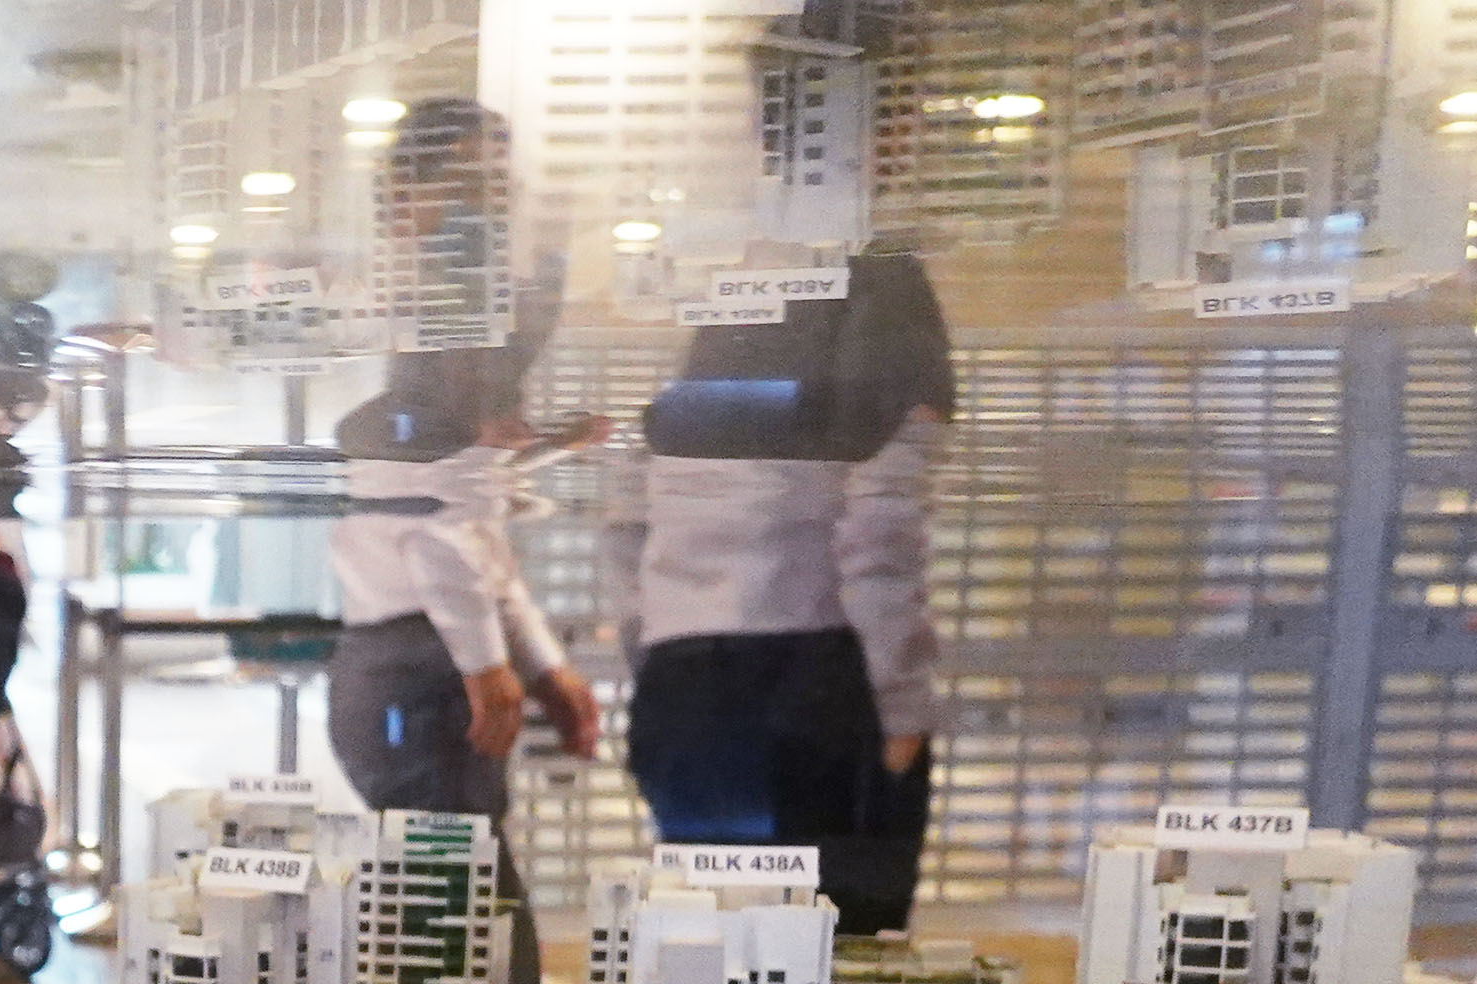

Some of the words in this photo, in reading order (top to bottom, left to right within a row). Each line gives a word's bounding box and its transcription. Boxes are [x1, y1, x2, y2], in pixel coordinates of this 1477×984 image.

[1165, 812, 1219, 831] BLK
[1228, 815, 1292, 834] 437B
[210, 856, 249, 873] BLK
[254, 860, 301, 877] 438B
[662, 852, 684, 866] BL
[694, 854, 741, 871] BLK
[750, 854, 805, 872] 438A
